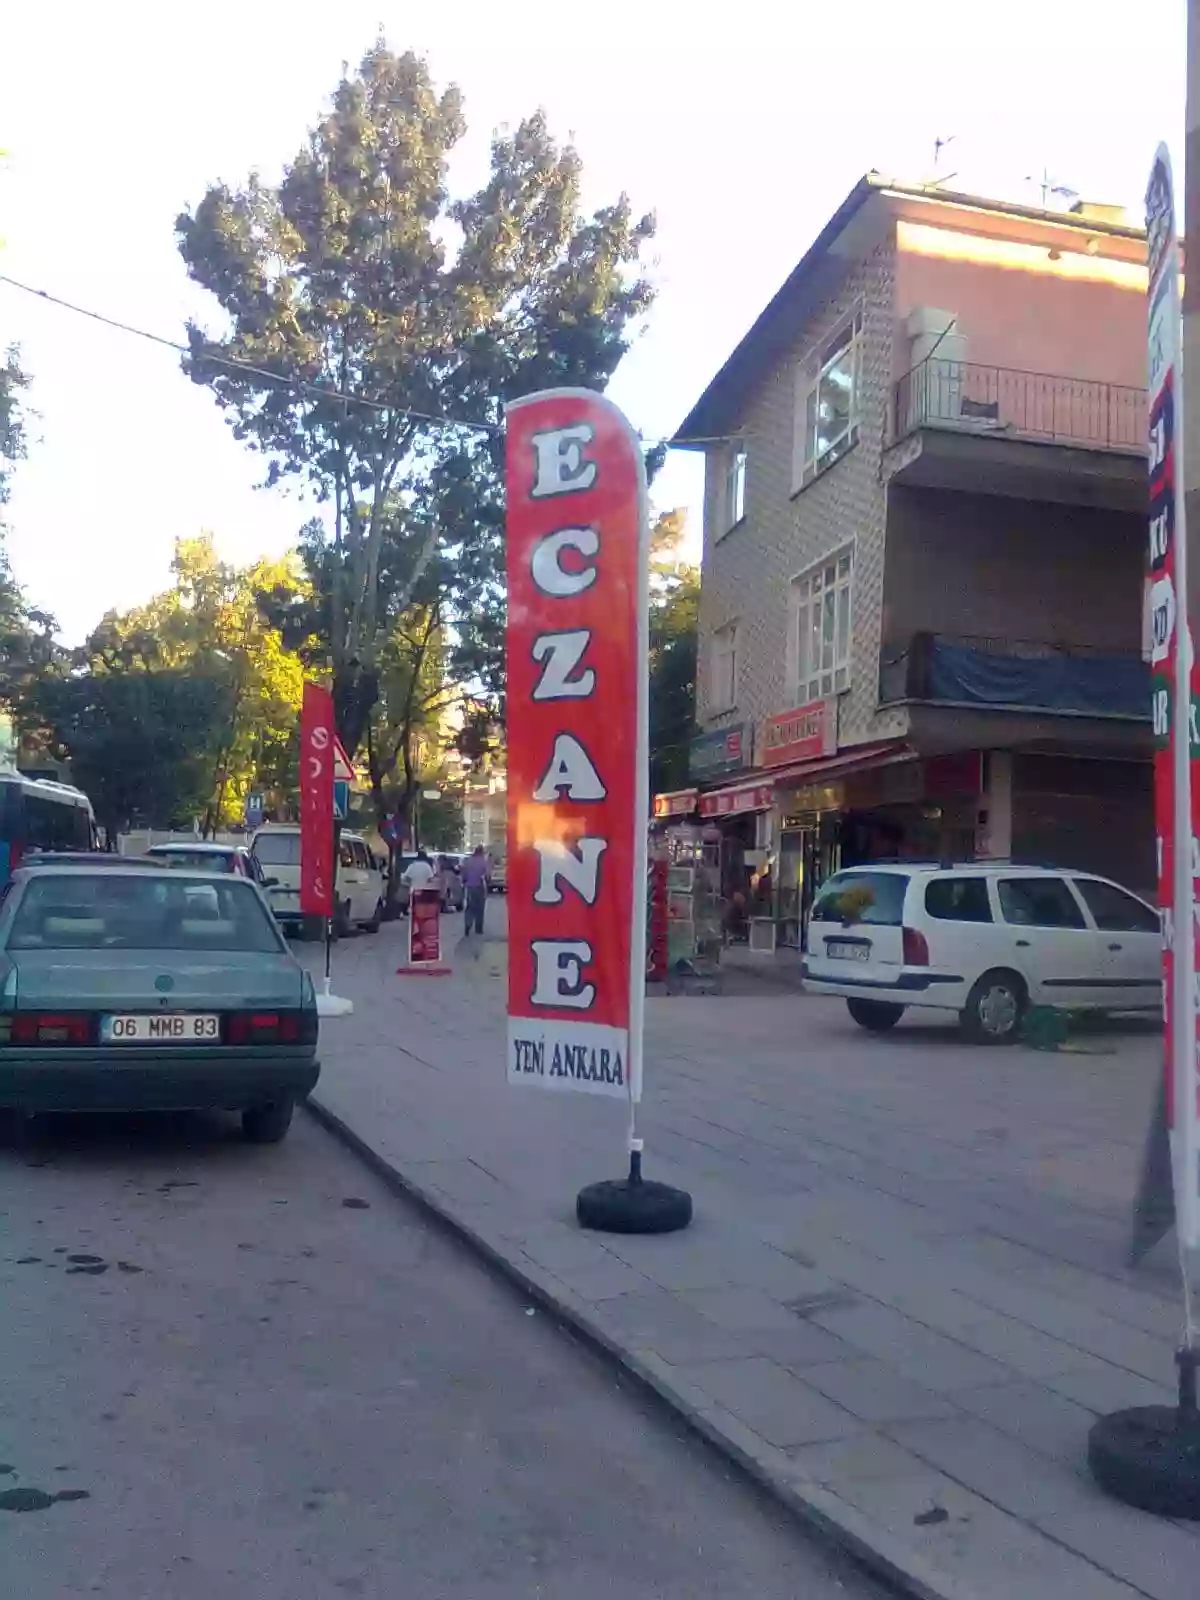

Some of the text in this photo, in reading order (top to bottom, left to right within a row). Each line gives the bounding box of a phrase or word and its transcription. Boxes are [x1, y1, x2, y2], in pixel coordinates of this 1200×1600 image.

[530, 423, 607, 1009] ECZANE
[112, 1018, 217, 1037] 06 MMB 83
[549, 1042, 623, 1086] ANKARA
